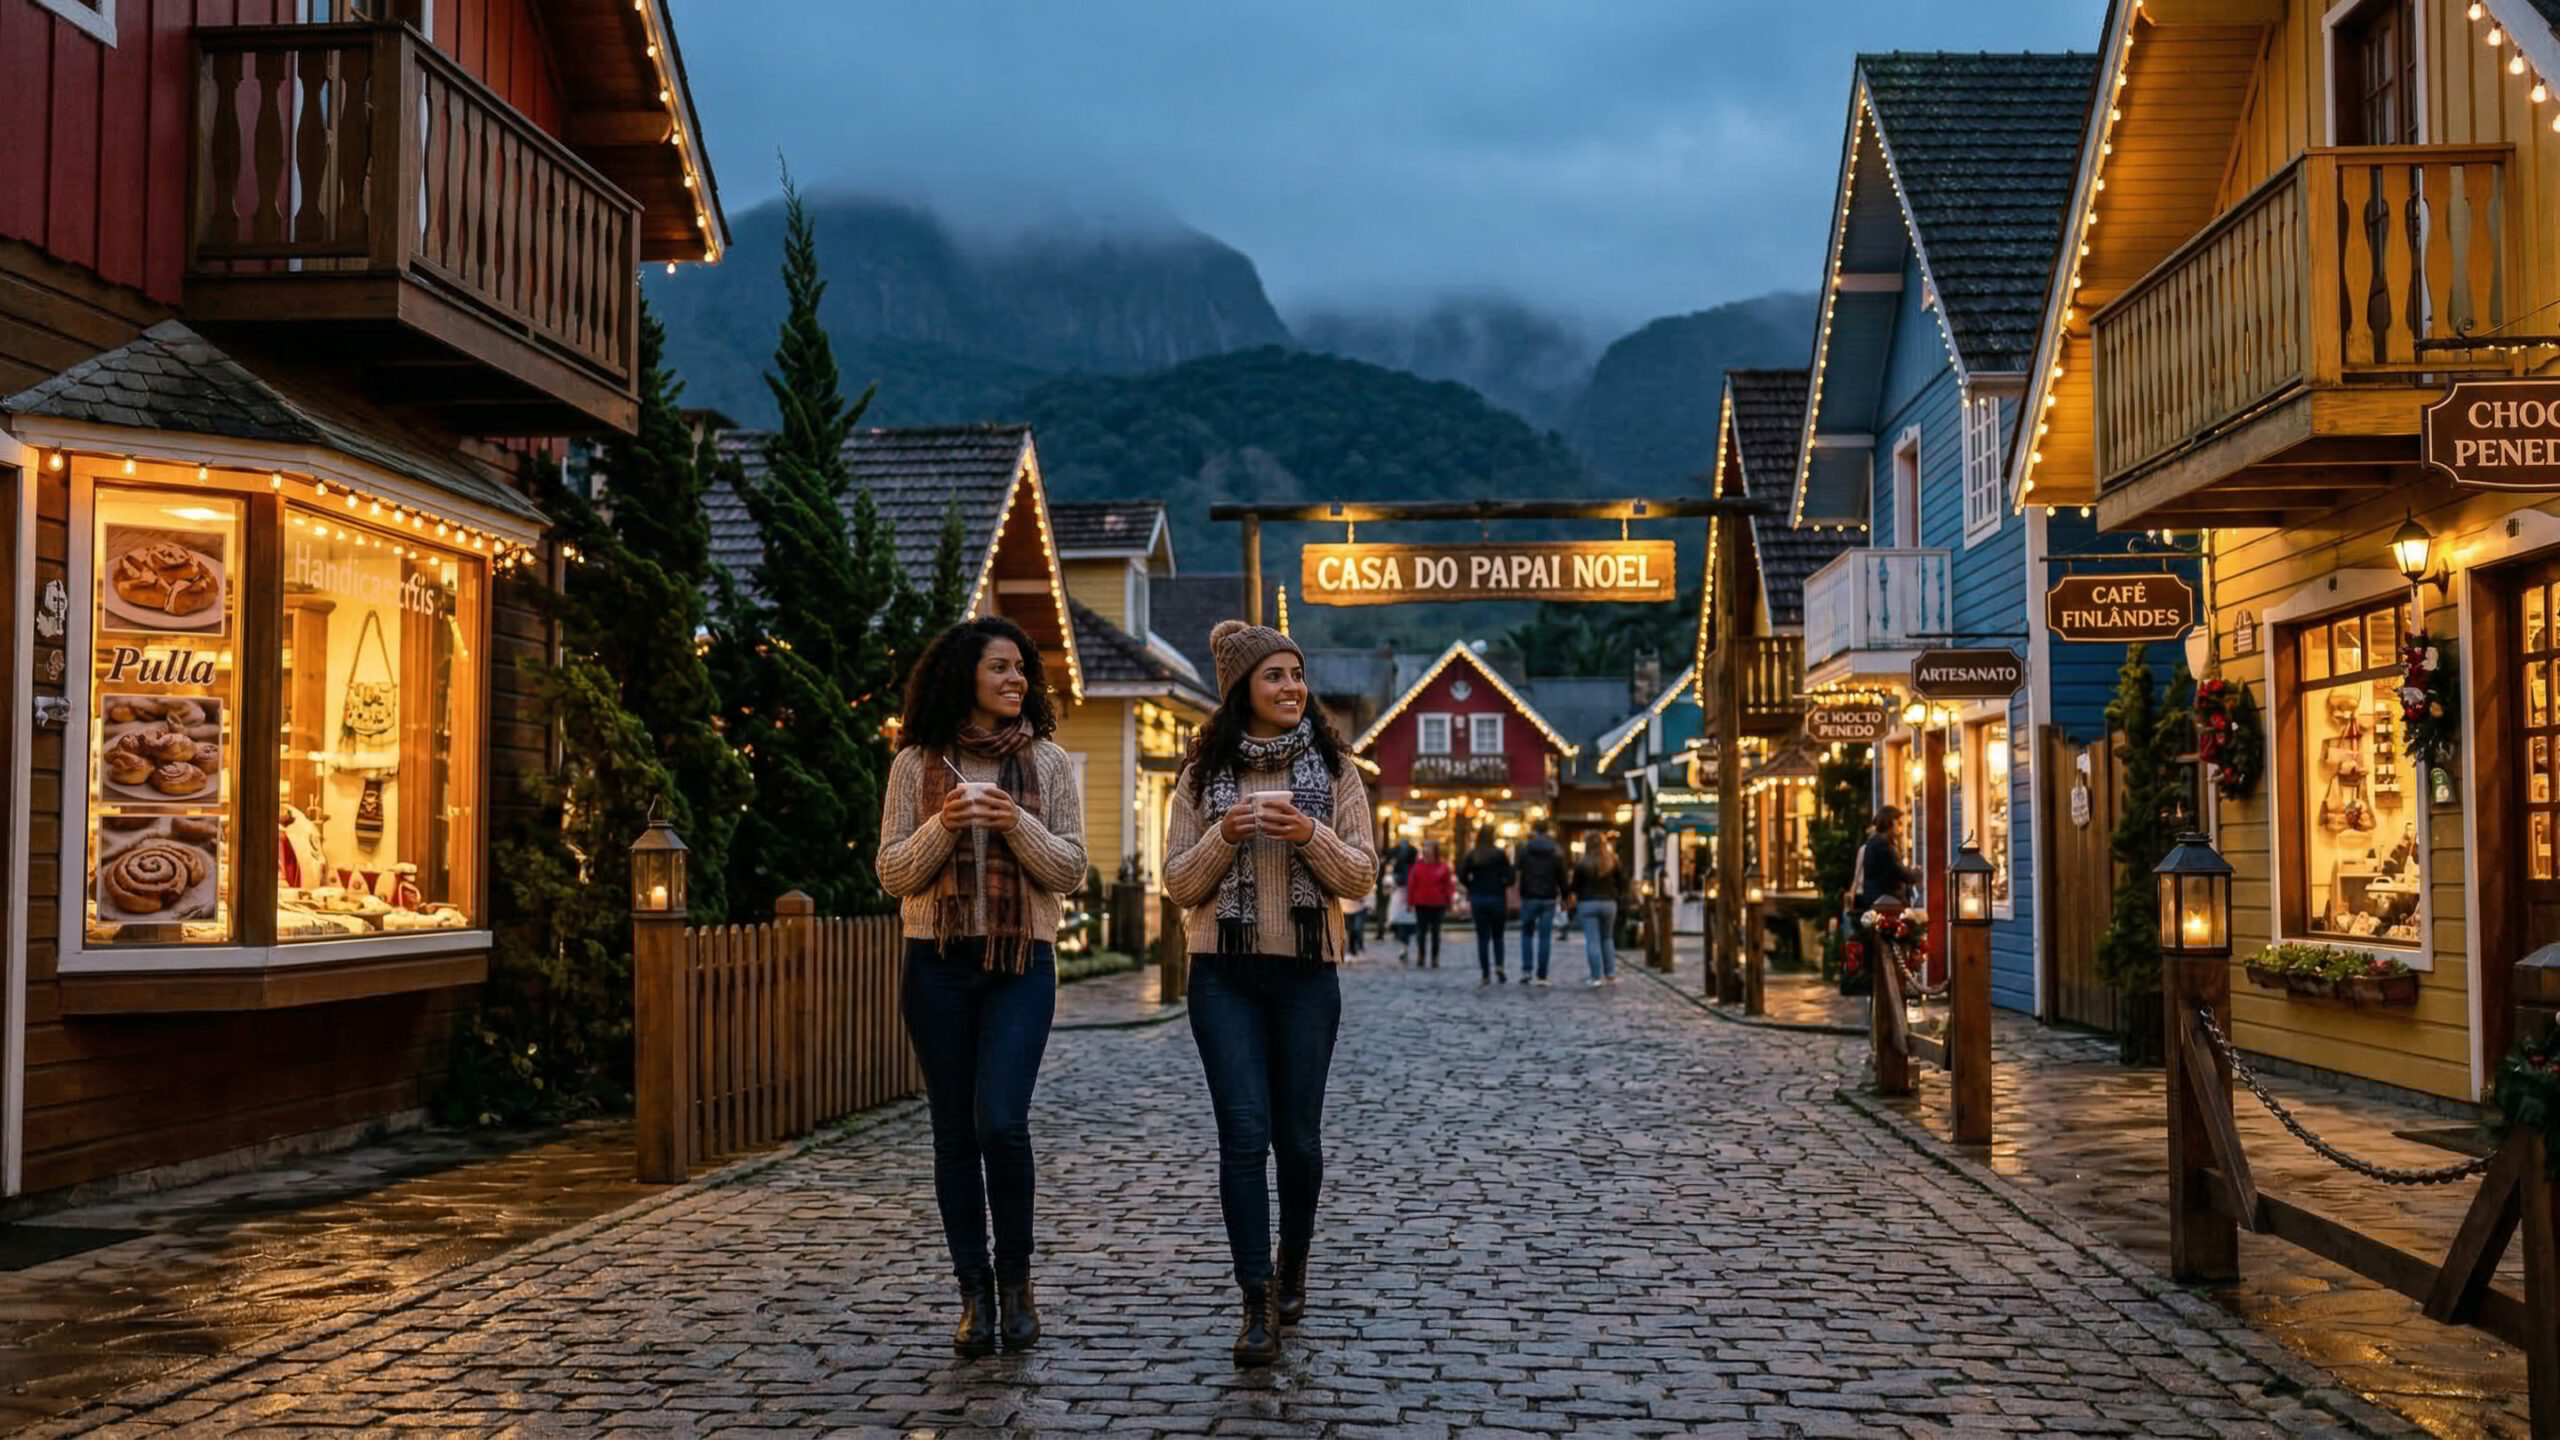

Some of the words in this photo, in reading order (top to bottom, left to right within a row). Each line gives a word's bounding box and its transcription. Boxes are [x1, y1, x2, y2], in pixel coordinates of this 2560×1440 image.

[1317, 556, 1403, 591] CASA
[1414, 556, 1459, 589] DO
[1470, 554, 1561, 589] PAPAI
[1573, 554, 1660, 589] NOEL
[2091, 582, 2147, 604] CAFÉ
[2061, 606, 2180, 628] FINLÂNDES
[104, 646, 216, 686] Pulla
[1919, 667, 2017, 681] ARTESANATO
[1819, 724, 1875, 736] PENEDO
